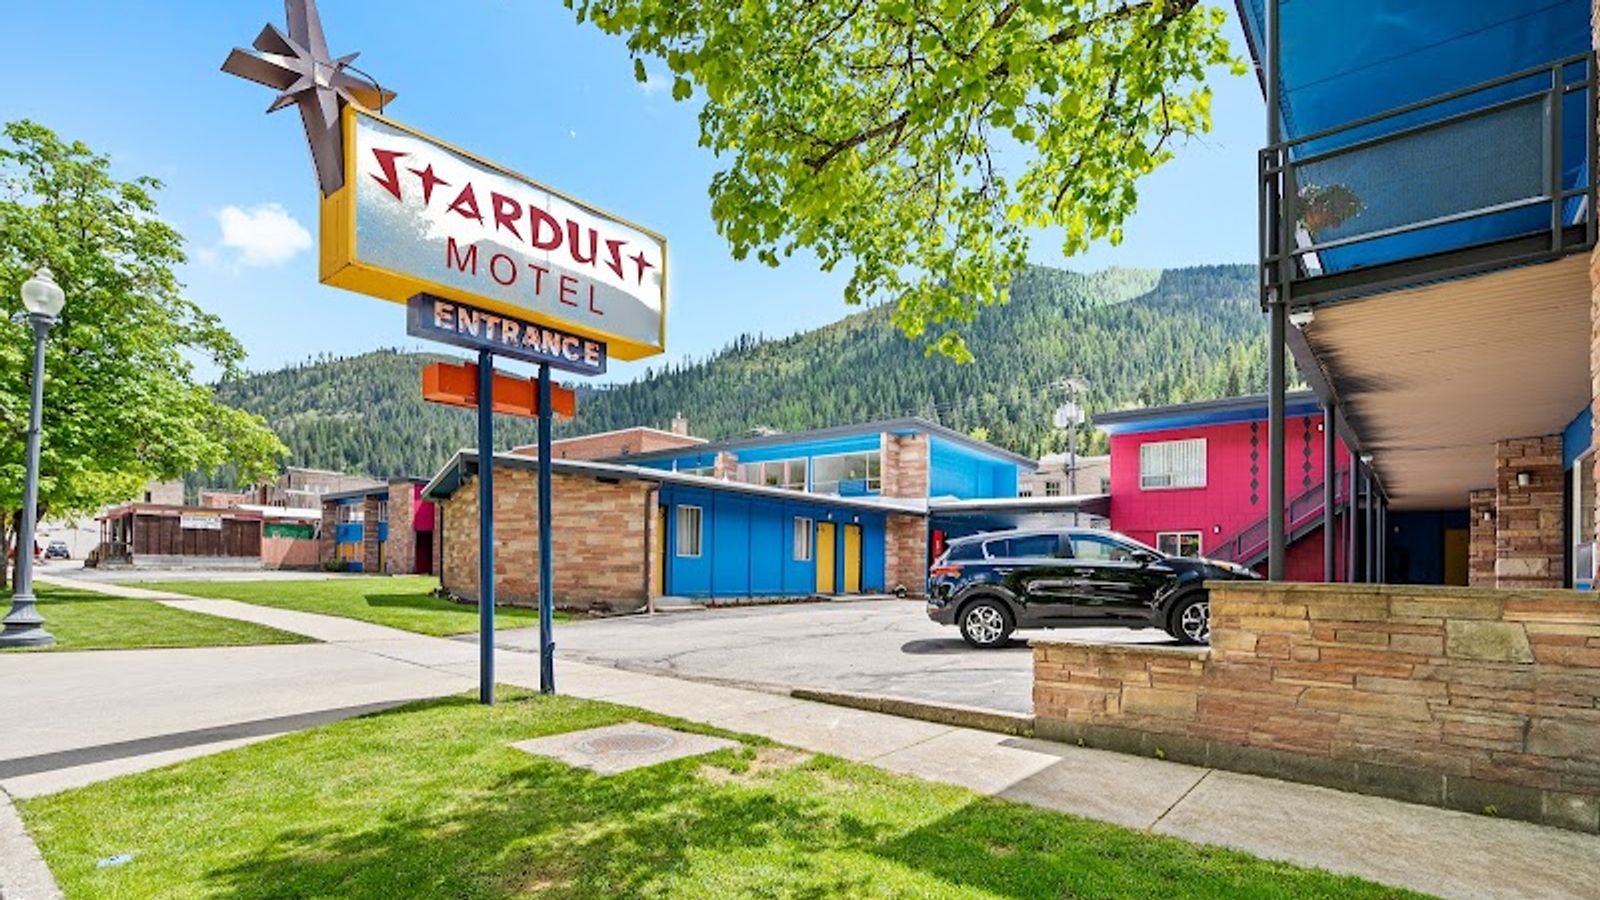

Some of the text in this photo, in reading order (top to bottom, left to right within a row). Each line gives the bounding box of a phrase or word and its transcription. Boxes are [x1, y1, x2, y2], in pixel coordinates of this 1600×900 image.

[369, 148, 655, 285] STARDUST
[447, 237, 604, 315] MOTEL
[434, 301, 601, 366] ENTRANCE
